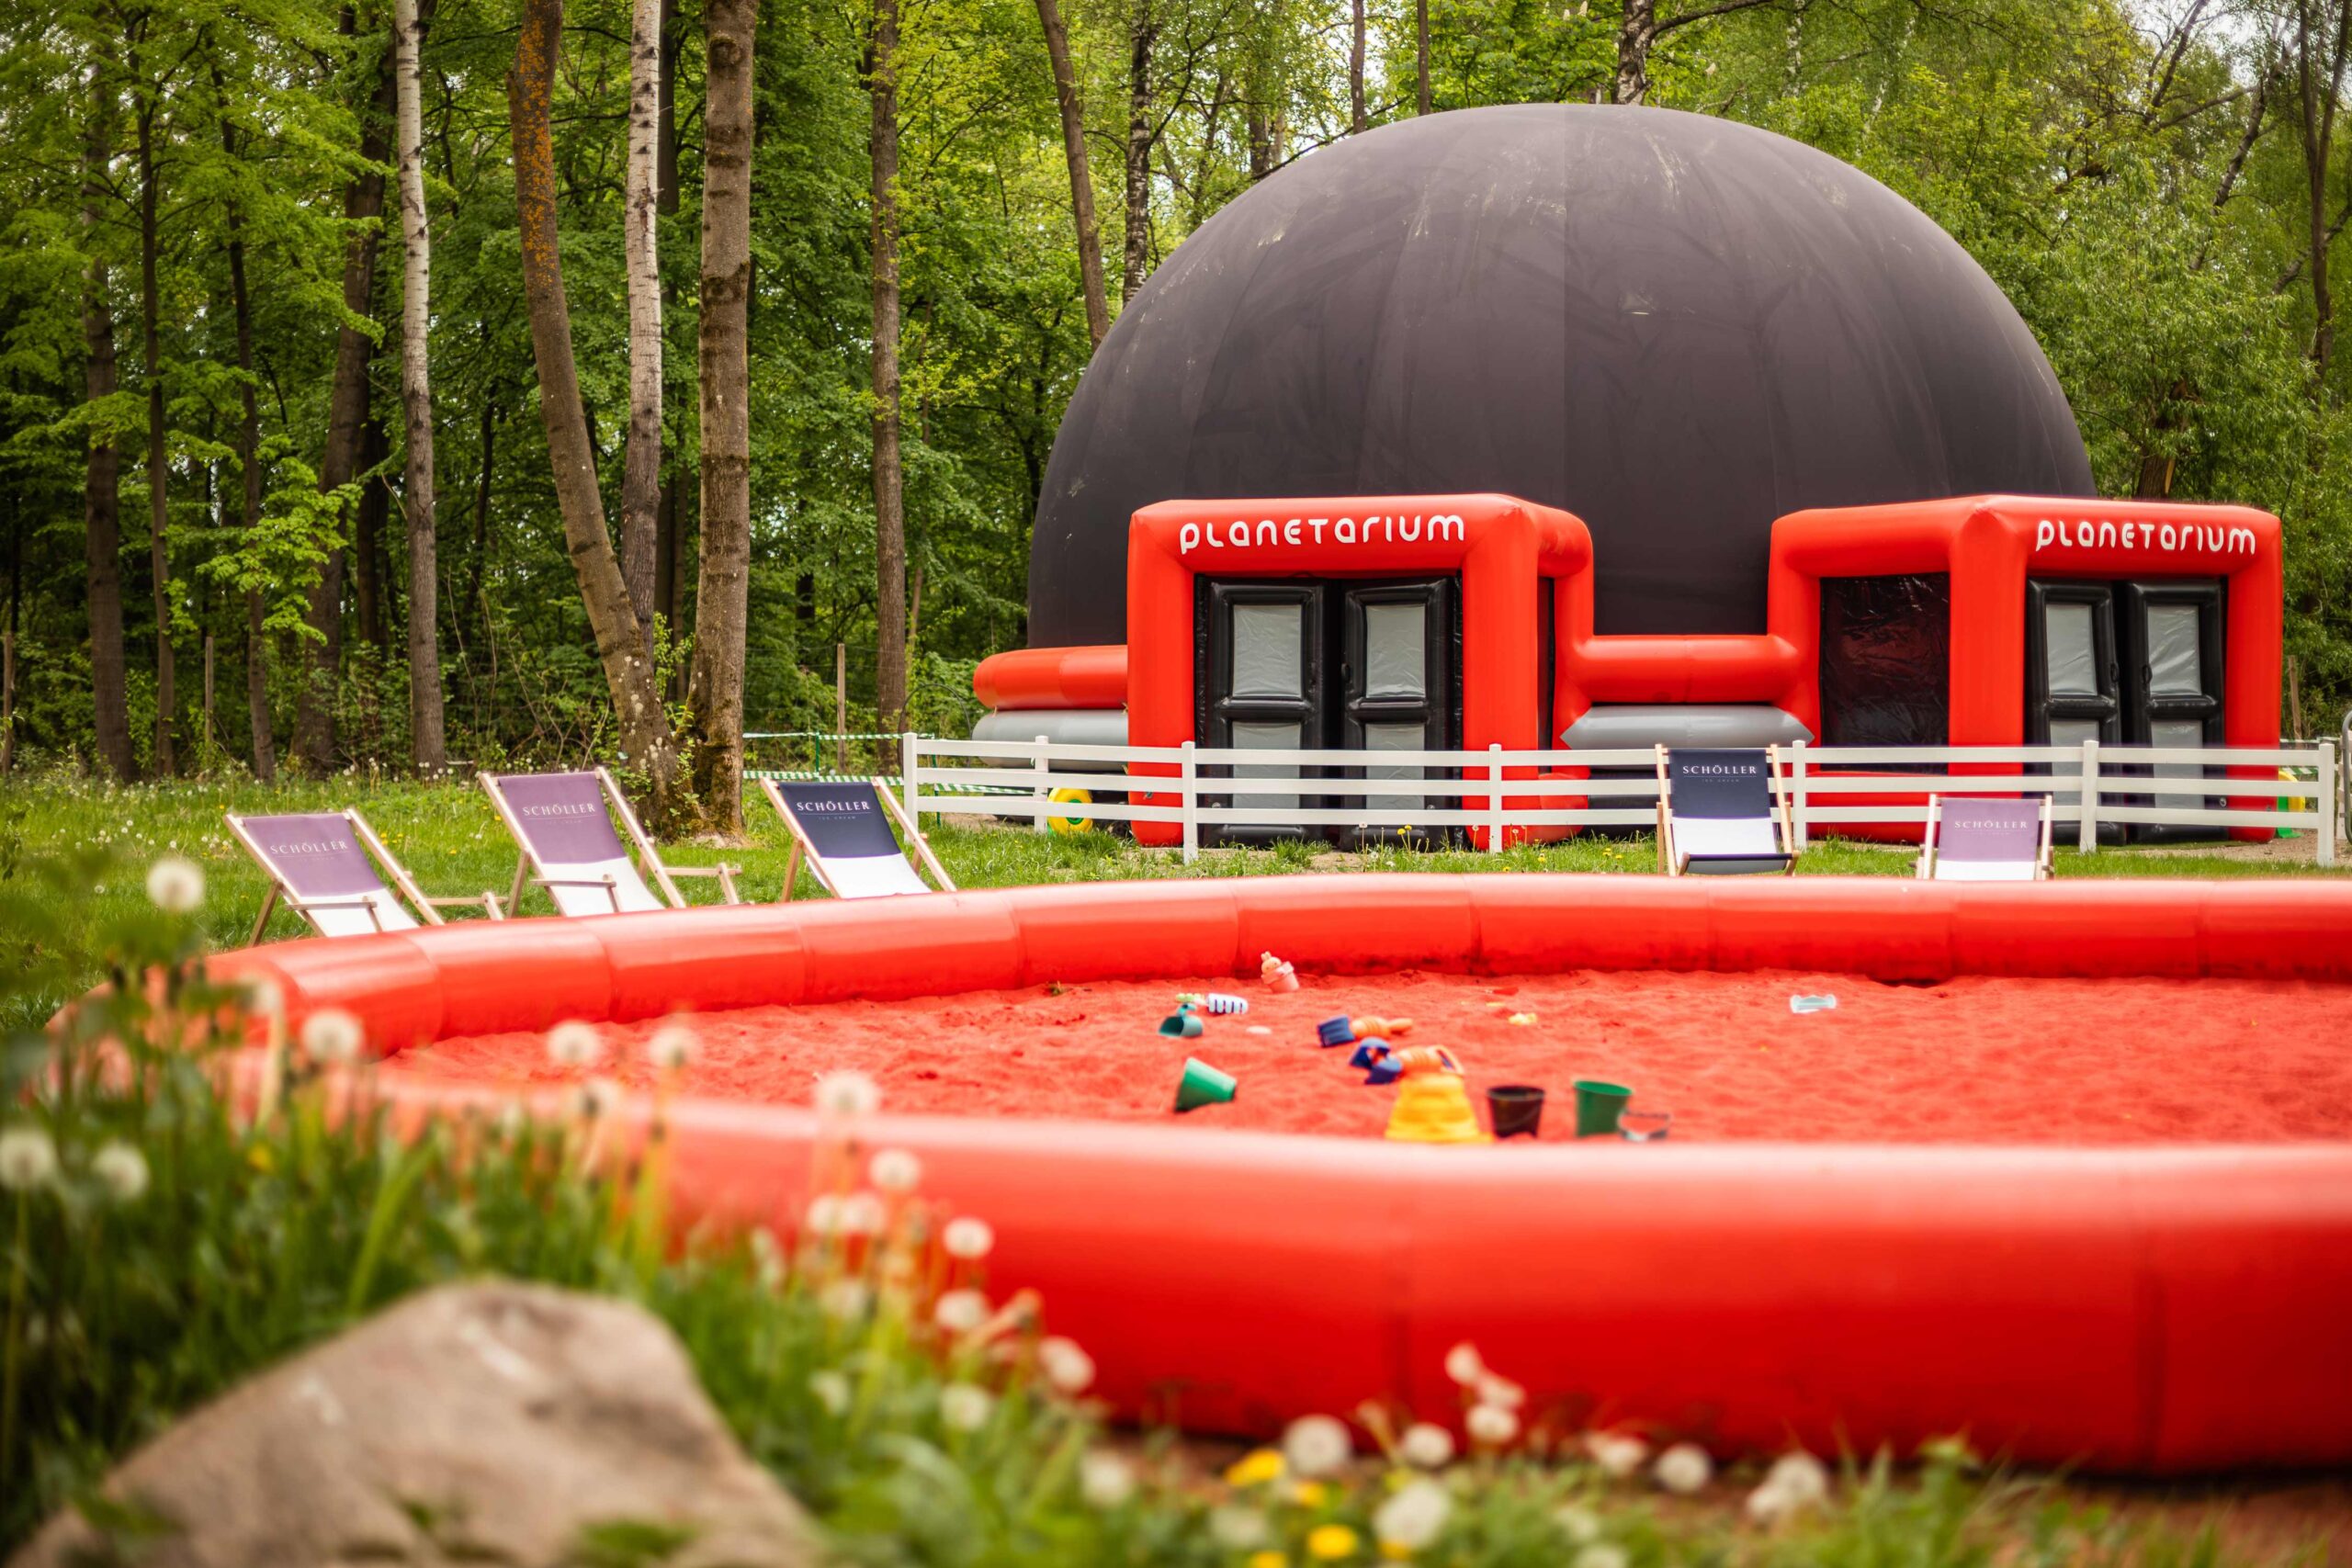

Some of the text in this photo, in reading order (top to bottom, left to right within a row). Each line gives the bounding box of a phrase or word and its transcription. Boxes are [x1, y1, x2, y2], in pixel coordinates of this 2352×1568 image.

[1682, 764, 1757, 774] SCHÖLLER
[522, 803, 596, 817] SCHÖLLER
[797, 800, 871, 811] SCHÖLLER
